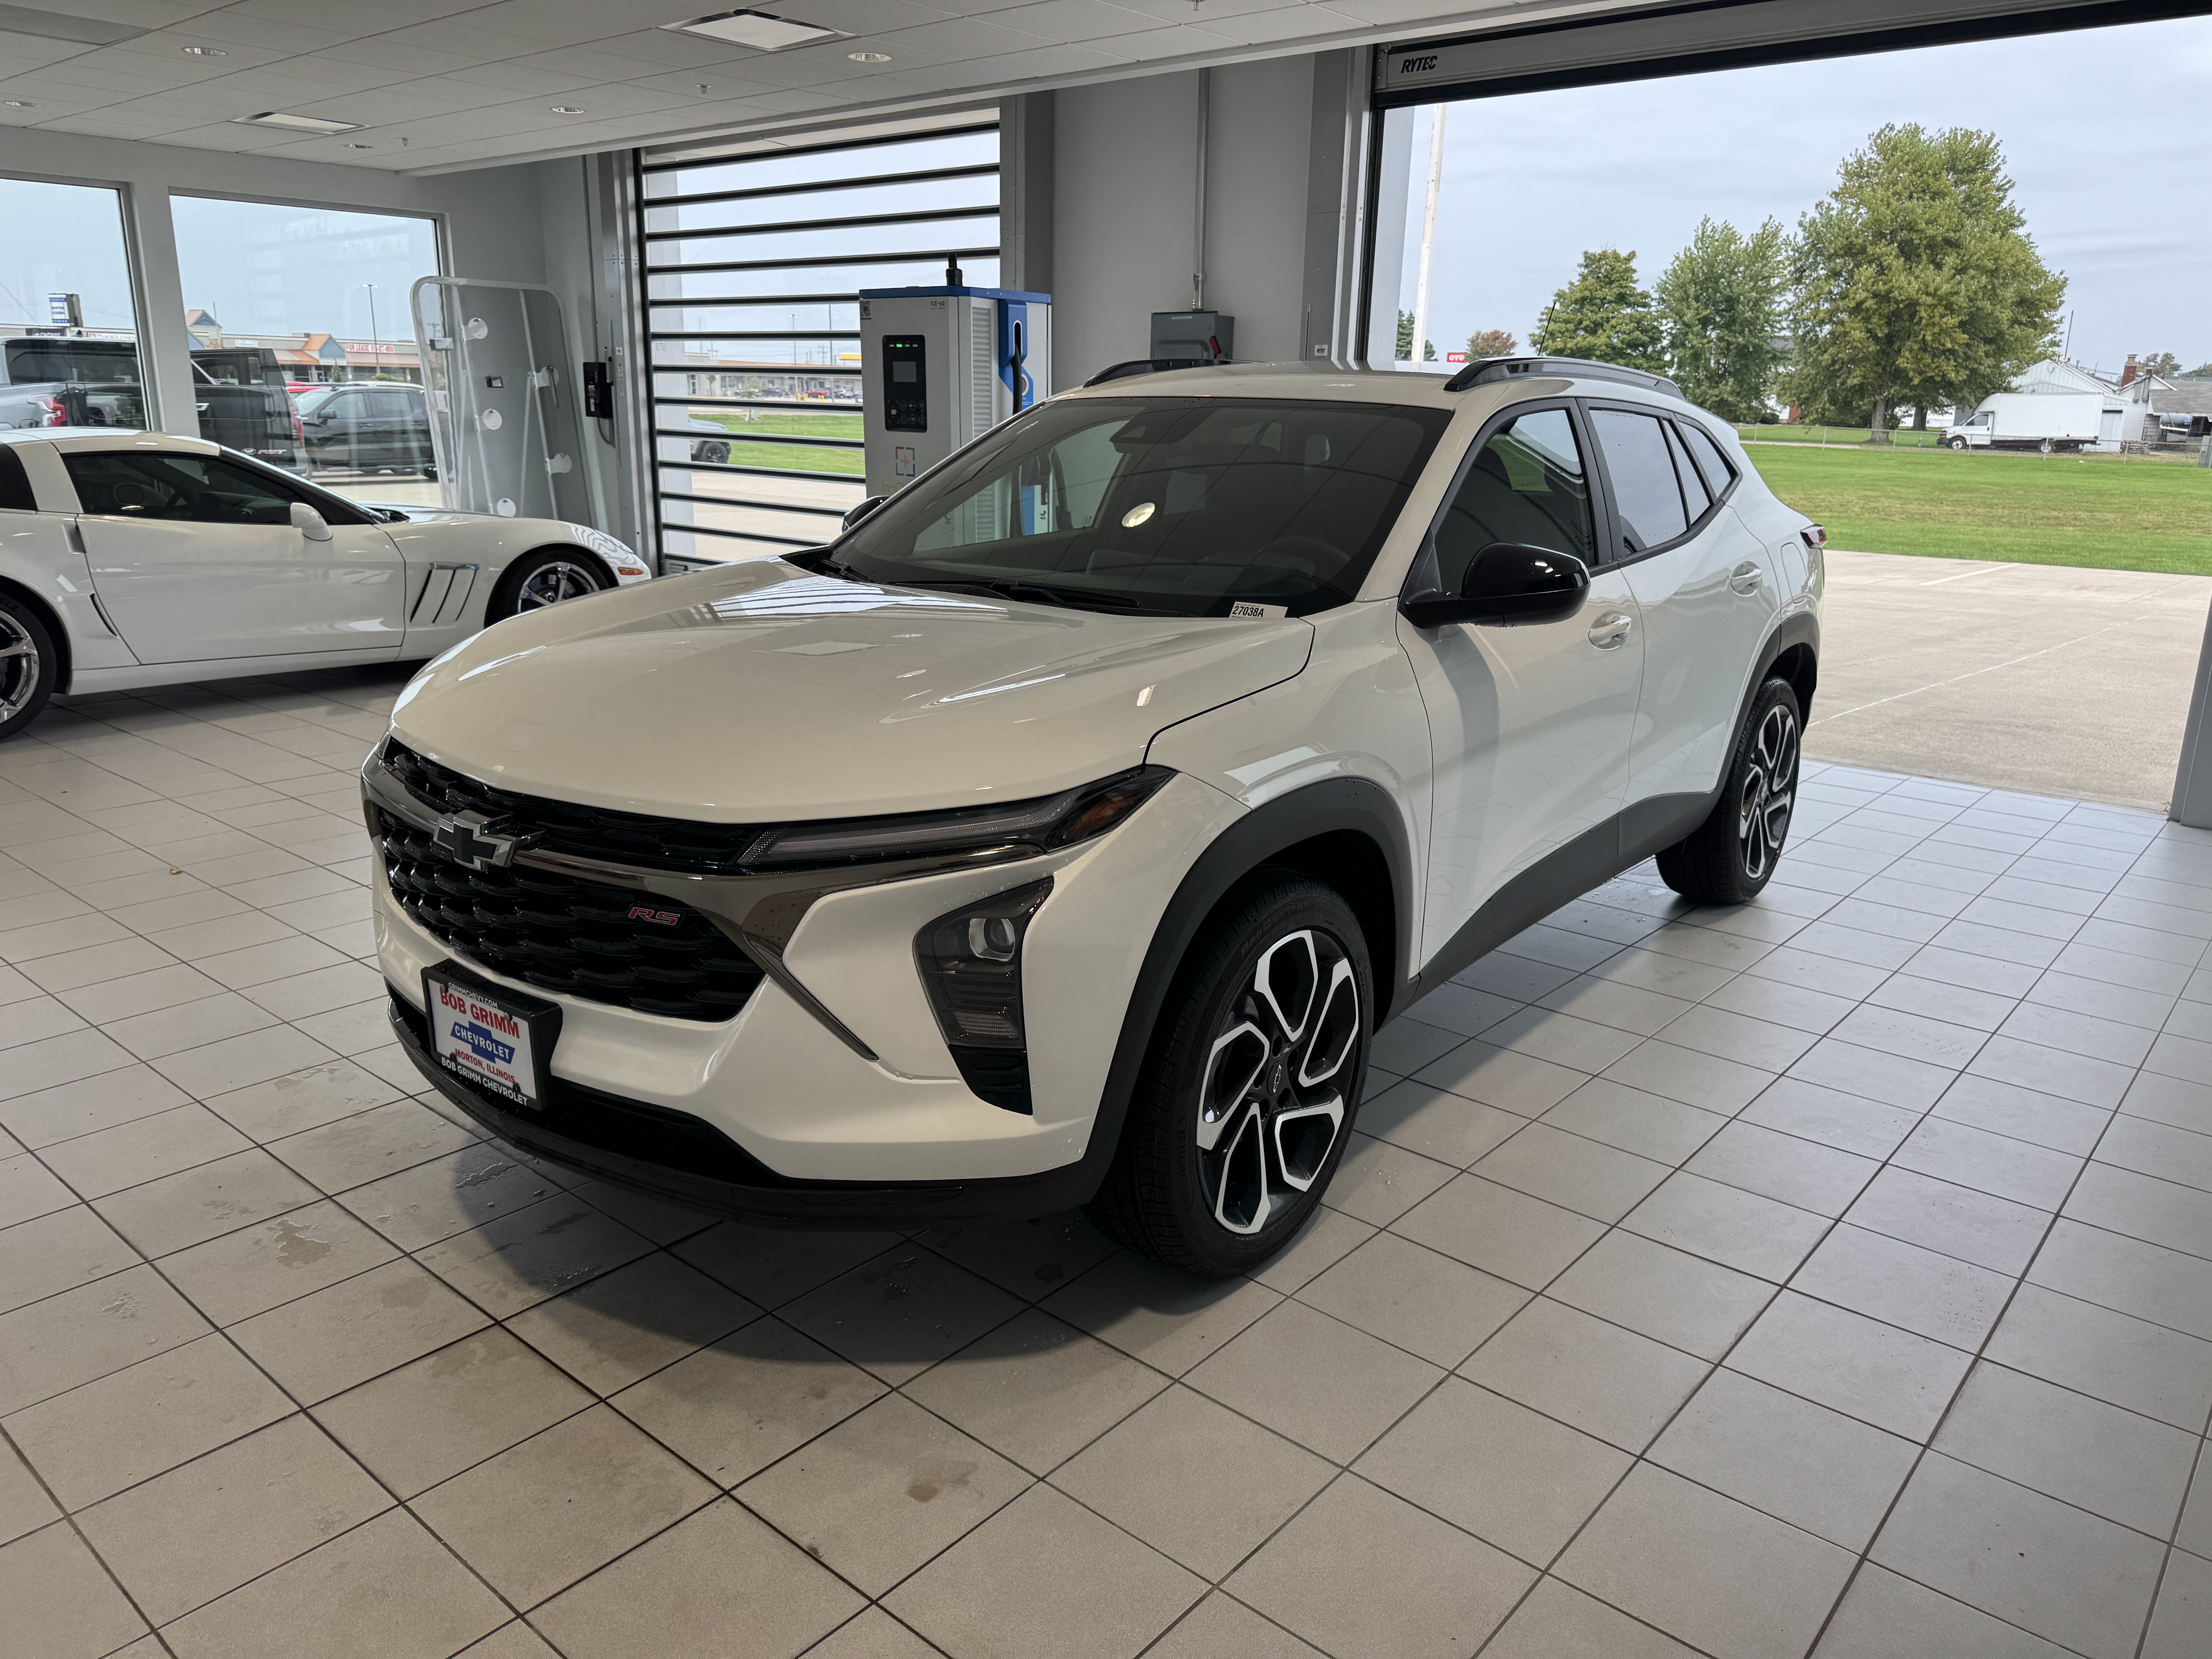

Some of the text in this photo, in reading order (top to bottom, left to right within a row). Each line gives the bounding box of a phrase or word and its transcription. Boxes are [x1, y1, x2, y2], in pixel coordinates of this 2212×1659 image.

[1401, 55, 1437, 73] RYTEC
[1232, 606, 1264, 617] 27038A
[629, 907, 680, 925] RS
[448, 982, 498, 1009] GRIMMCHEVY.COM
[440, 990, 520, 1039] BOB GRIMM
[455, 1026, 509, 1059] CHEVROLET
[441, 1056, 527, 1106] BOB GRIMM CHEVROLET
[455, 1048, 515, 1084] MORTON, ILLINOIS
